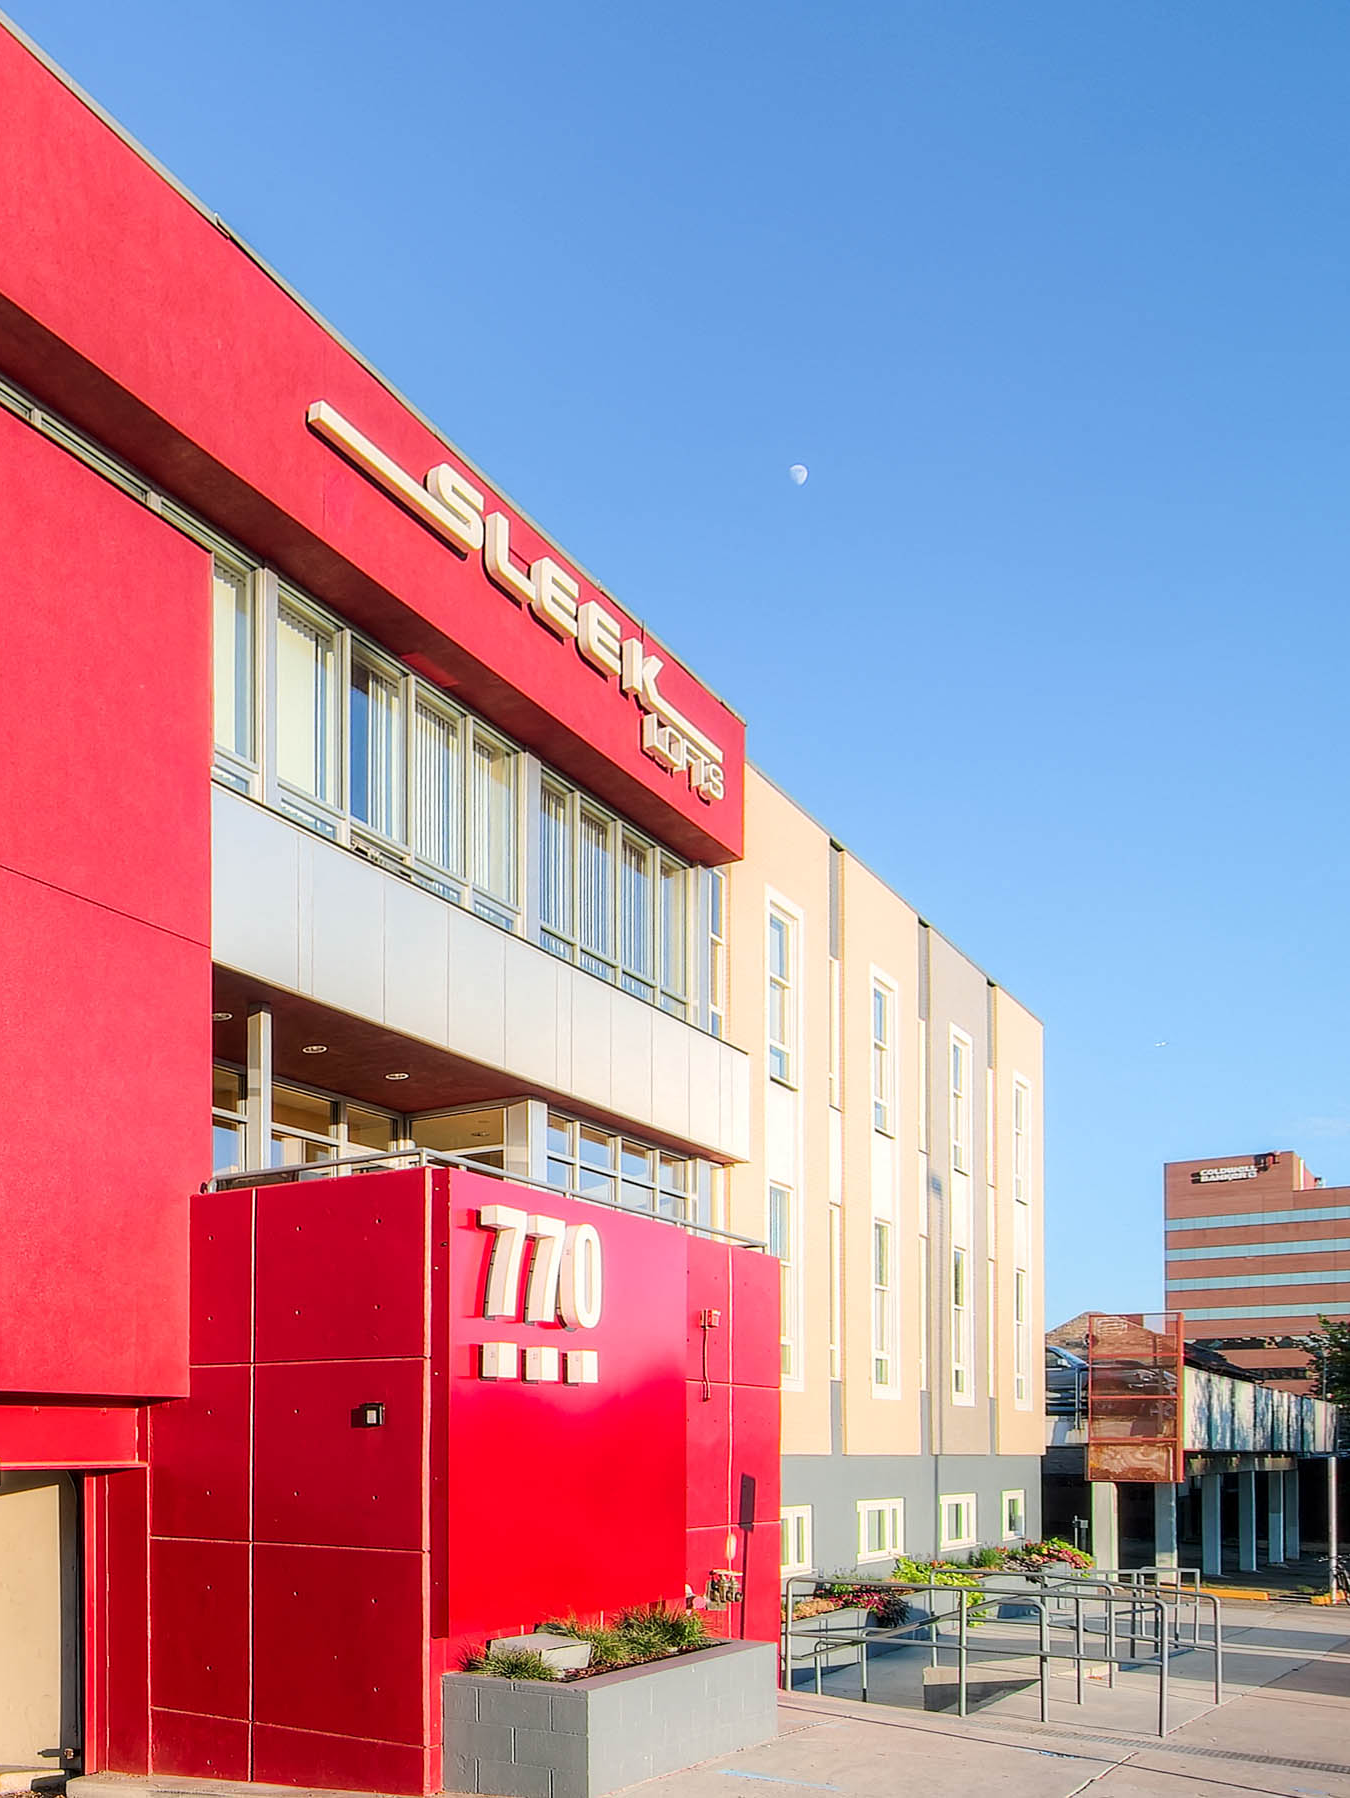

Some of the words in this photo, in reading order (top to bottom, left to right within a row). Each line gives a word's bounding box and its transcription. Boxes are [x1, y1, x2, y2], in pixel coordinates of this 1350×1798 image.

[308, 400, 724, 764] SLEEK
[643, 713, 724, 800] LOFTS
[480, 1204, 603, 1329] 770
